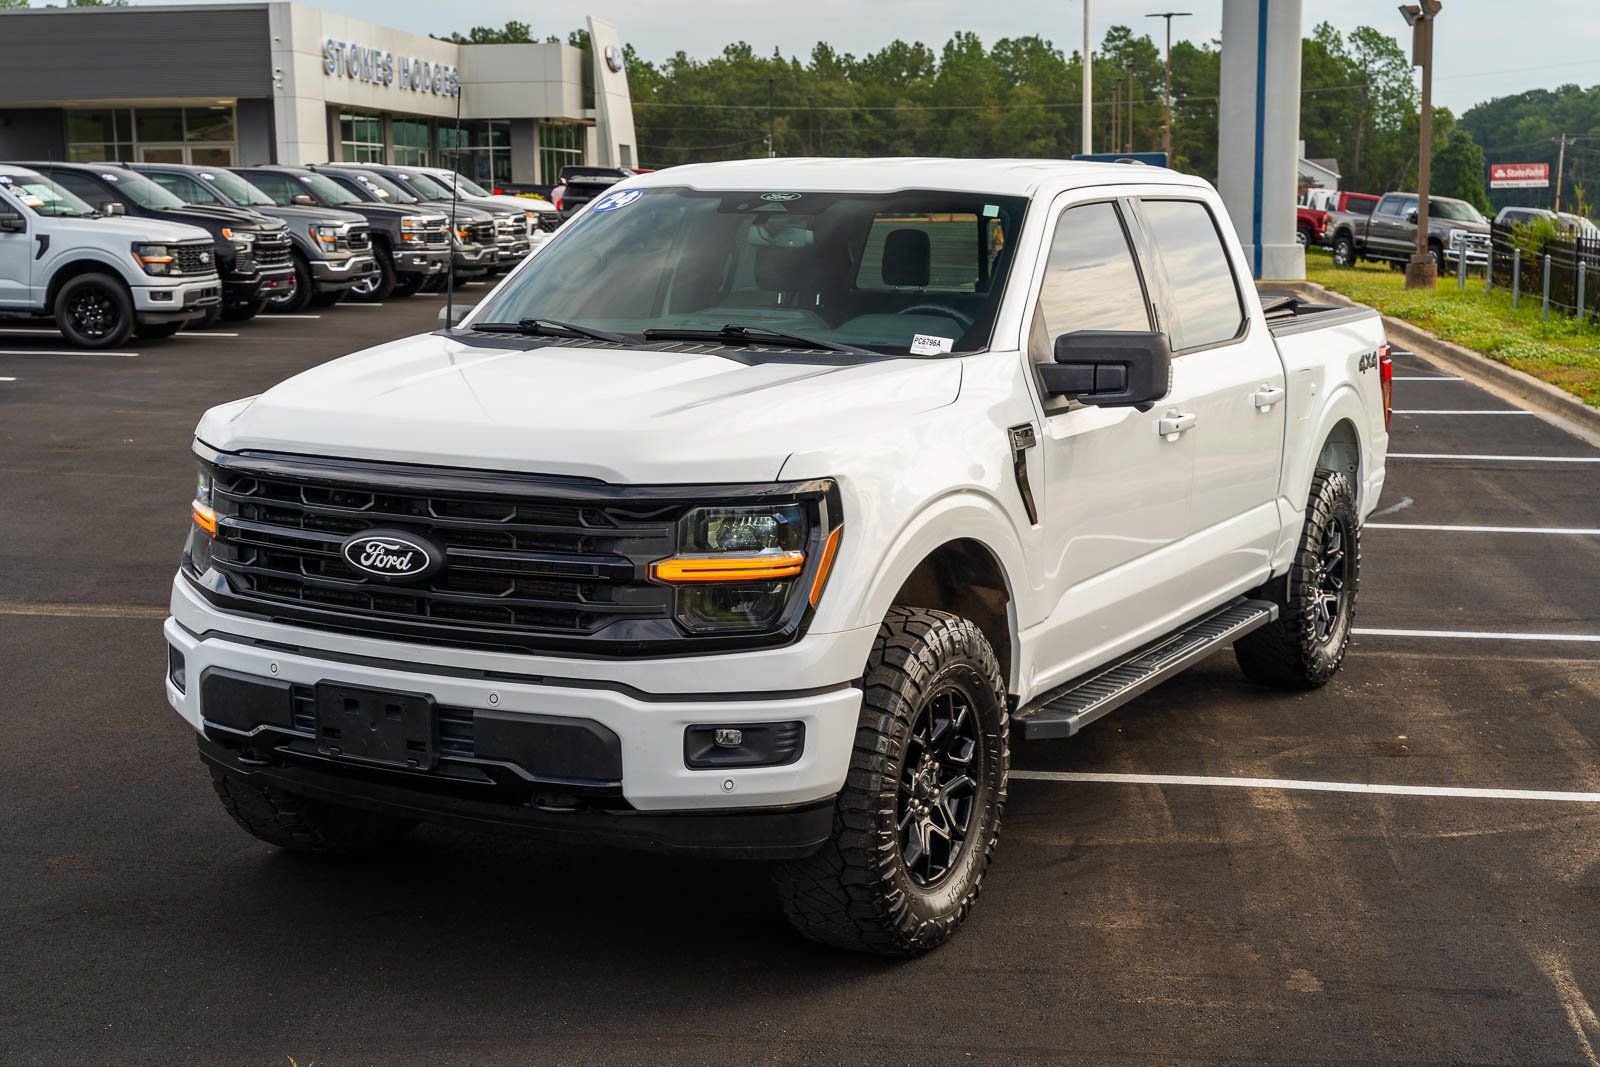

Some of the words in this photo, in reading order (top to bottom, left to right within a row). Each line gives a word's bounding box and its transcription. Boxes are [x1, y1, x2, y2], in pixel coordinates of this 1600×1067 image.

[323, 38, 394, 87] STOKES
[398, 56, 461, 97] HODGES
[361, 541, 413, 570] Ford
